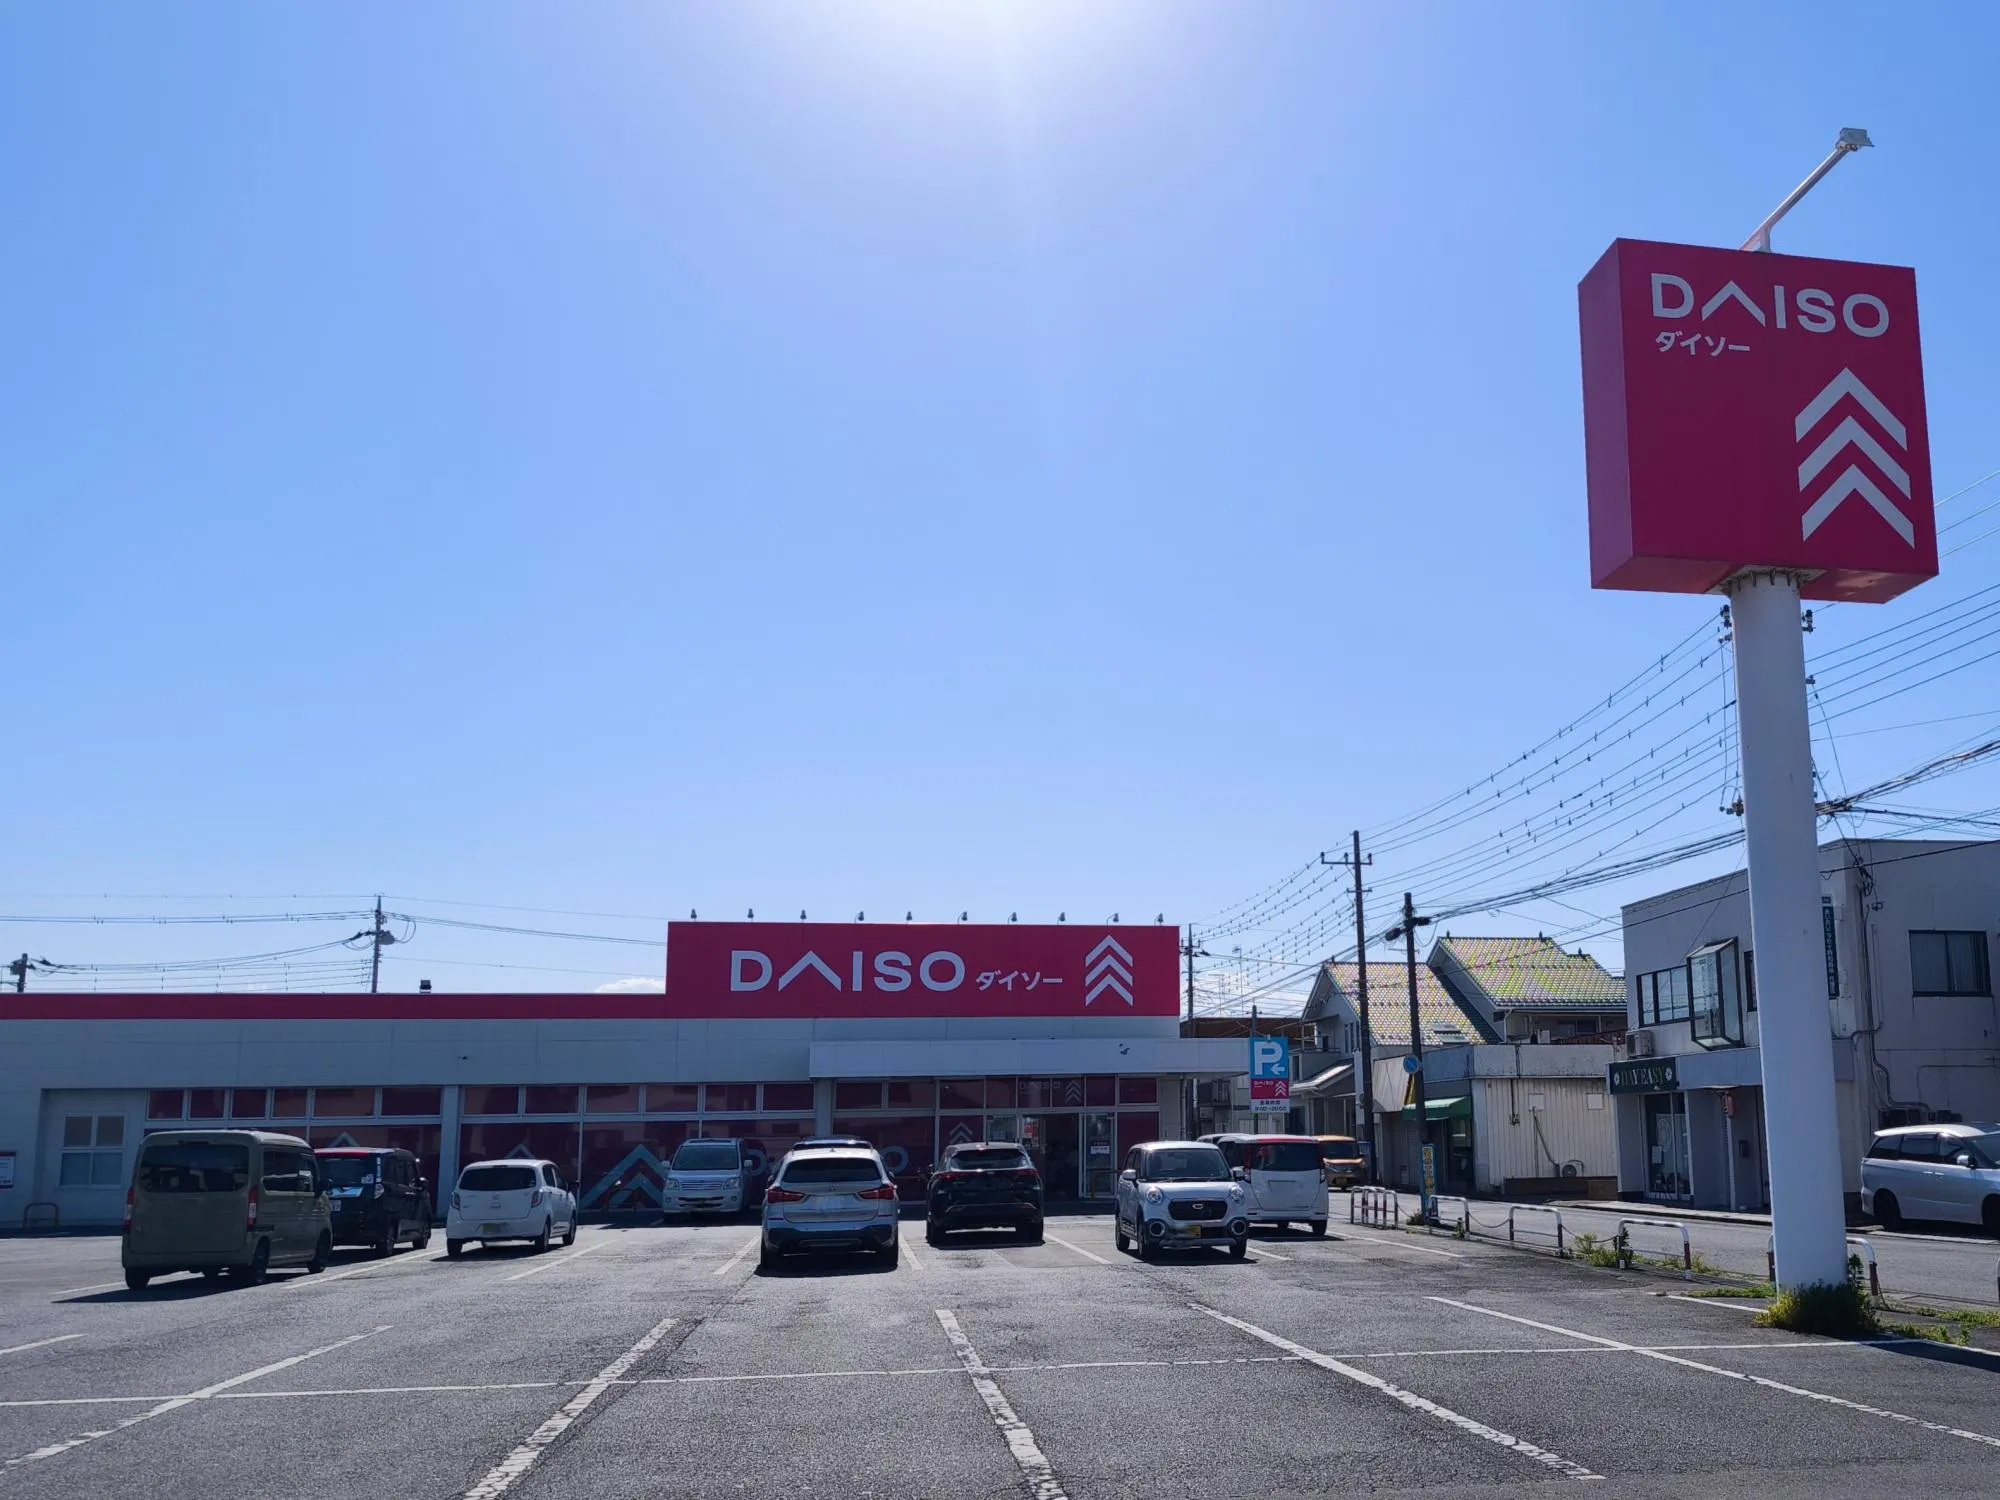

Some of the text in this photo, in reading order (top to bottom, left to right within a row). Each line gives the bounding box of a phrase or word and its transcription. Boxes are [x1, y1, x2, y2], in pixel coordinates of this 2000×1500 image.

[1650, 272, 1890, 338] DAISO
[1655, 330, 1751, 357] ダイソー
[730, 950, 1063, 992] DAISO ダイソー
[1254, 1041, 1283, 1075] P
